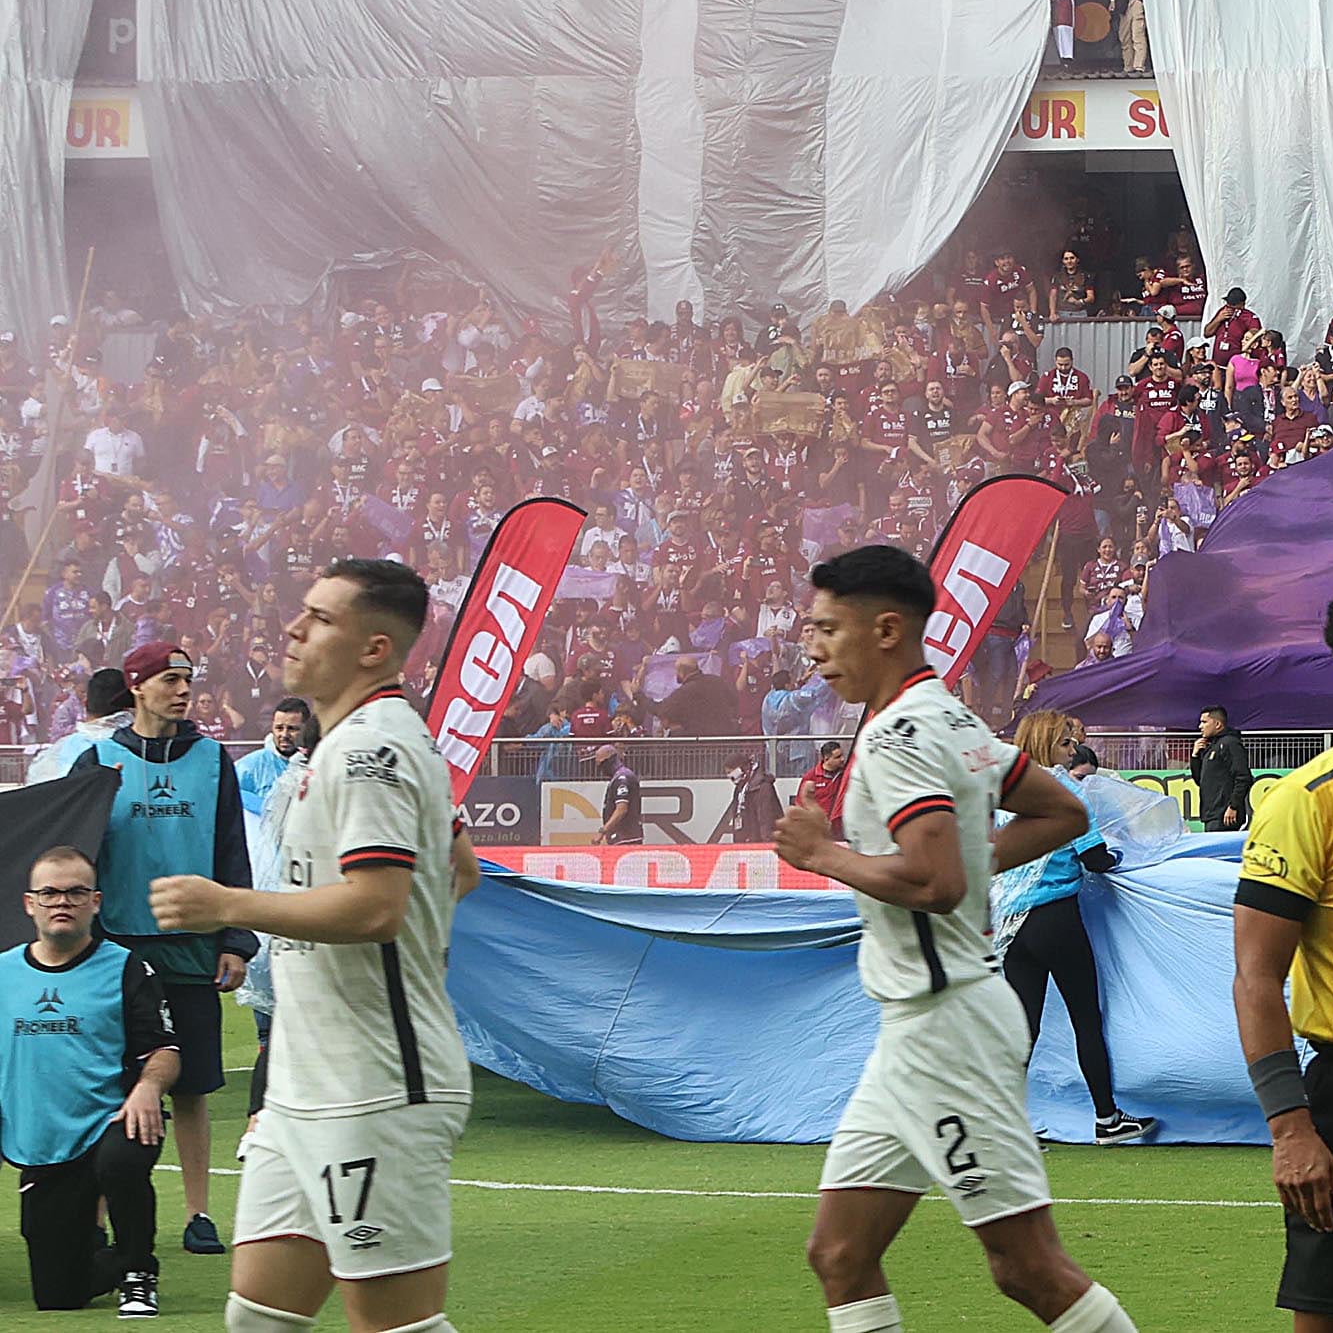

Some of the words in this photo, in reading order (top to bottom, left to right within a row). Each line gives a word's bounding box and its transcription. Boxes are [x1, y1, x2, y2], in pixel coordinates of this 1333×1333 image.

[920, 539, 1012, 678] CA
[435, 560, 543, 776] RCA
[130, 801, 192, 818] PIONEER
[14, 1016, 83, 1036] PIONEER
[937, 1114, 980, 1176] 2
[320, 1156, 378, 1225] 17
